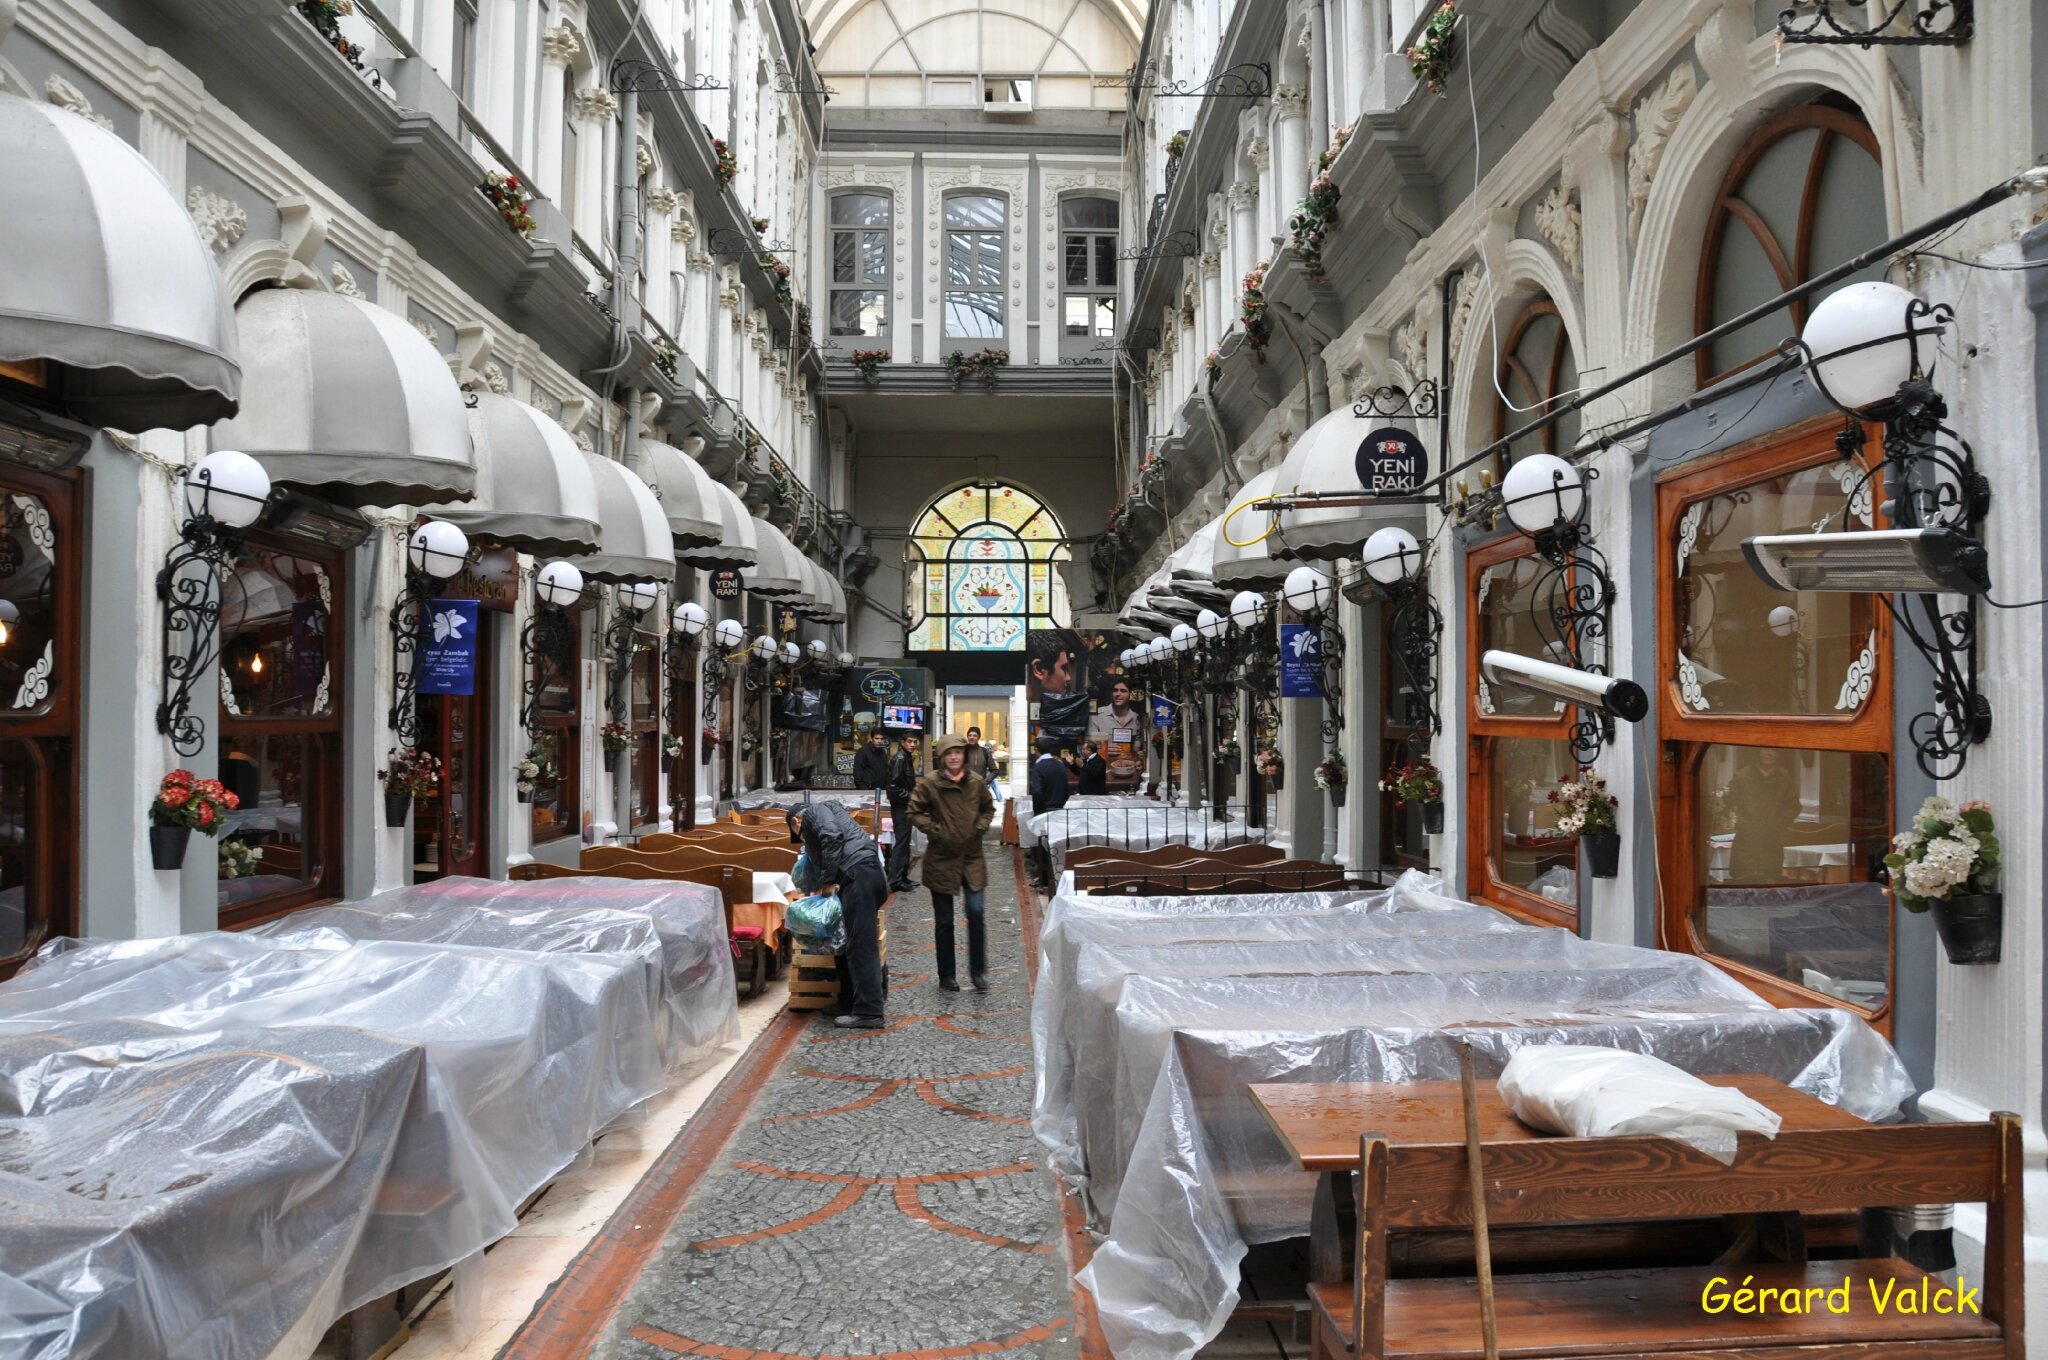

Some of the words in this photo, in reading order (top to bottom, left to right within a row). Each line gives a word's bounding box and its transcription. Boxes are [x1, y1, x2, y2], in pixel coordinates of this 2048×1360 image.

[1369, 456, 1415, 474] YENİ
[1372, 475, 1415, 489] RAKI
[715, 579, 738, 588] YENİ
[716, 588, 738, 596] RAKI
